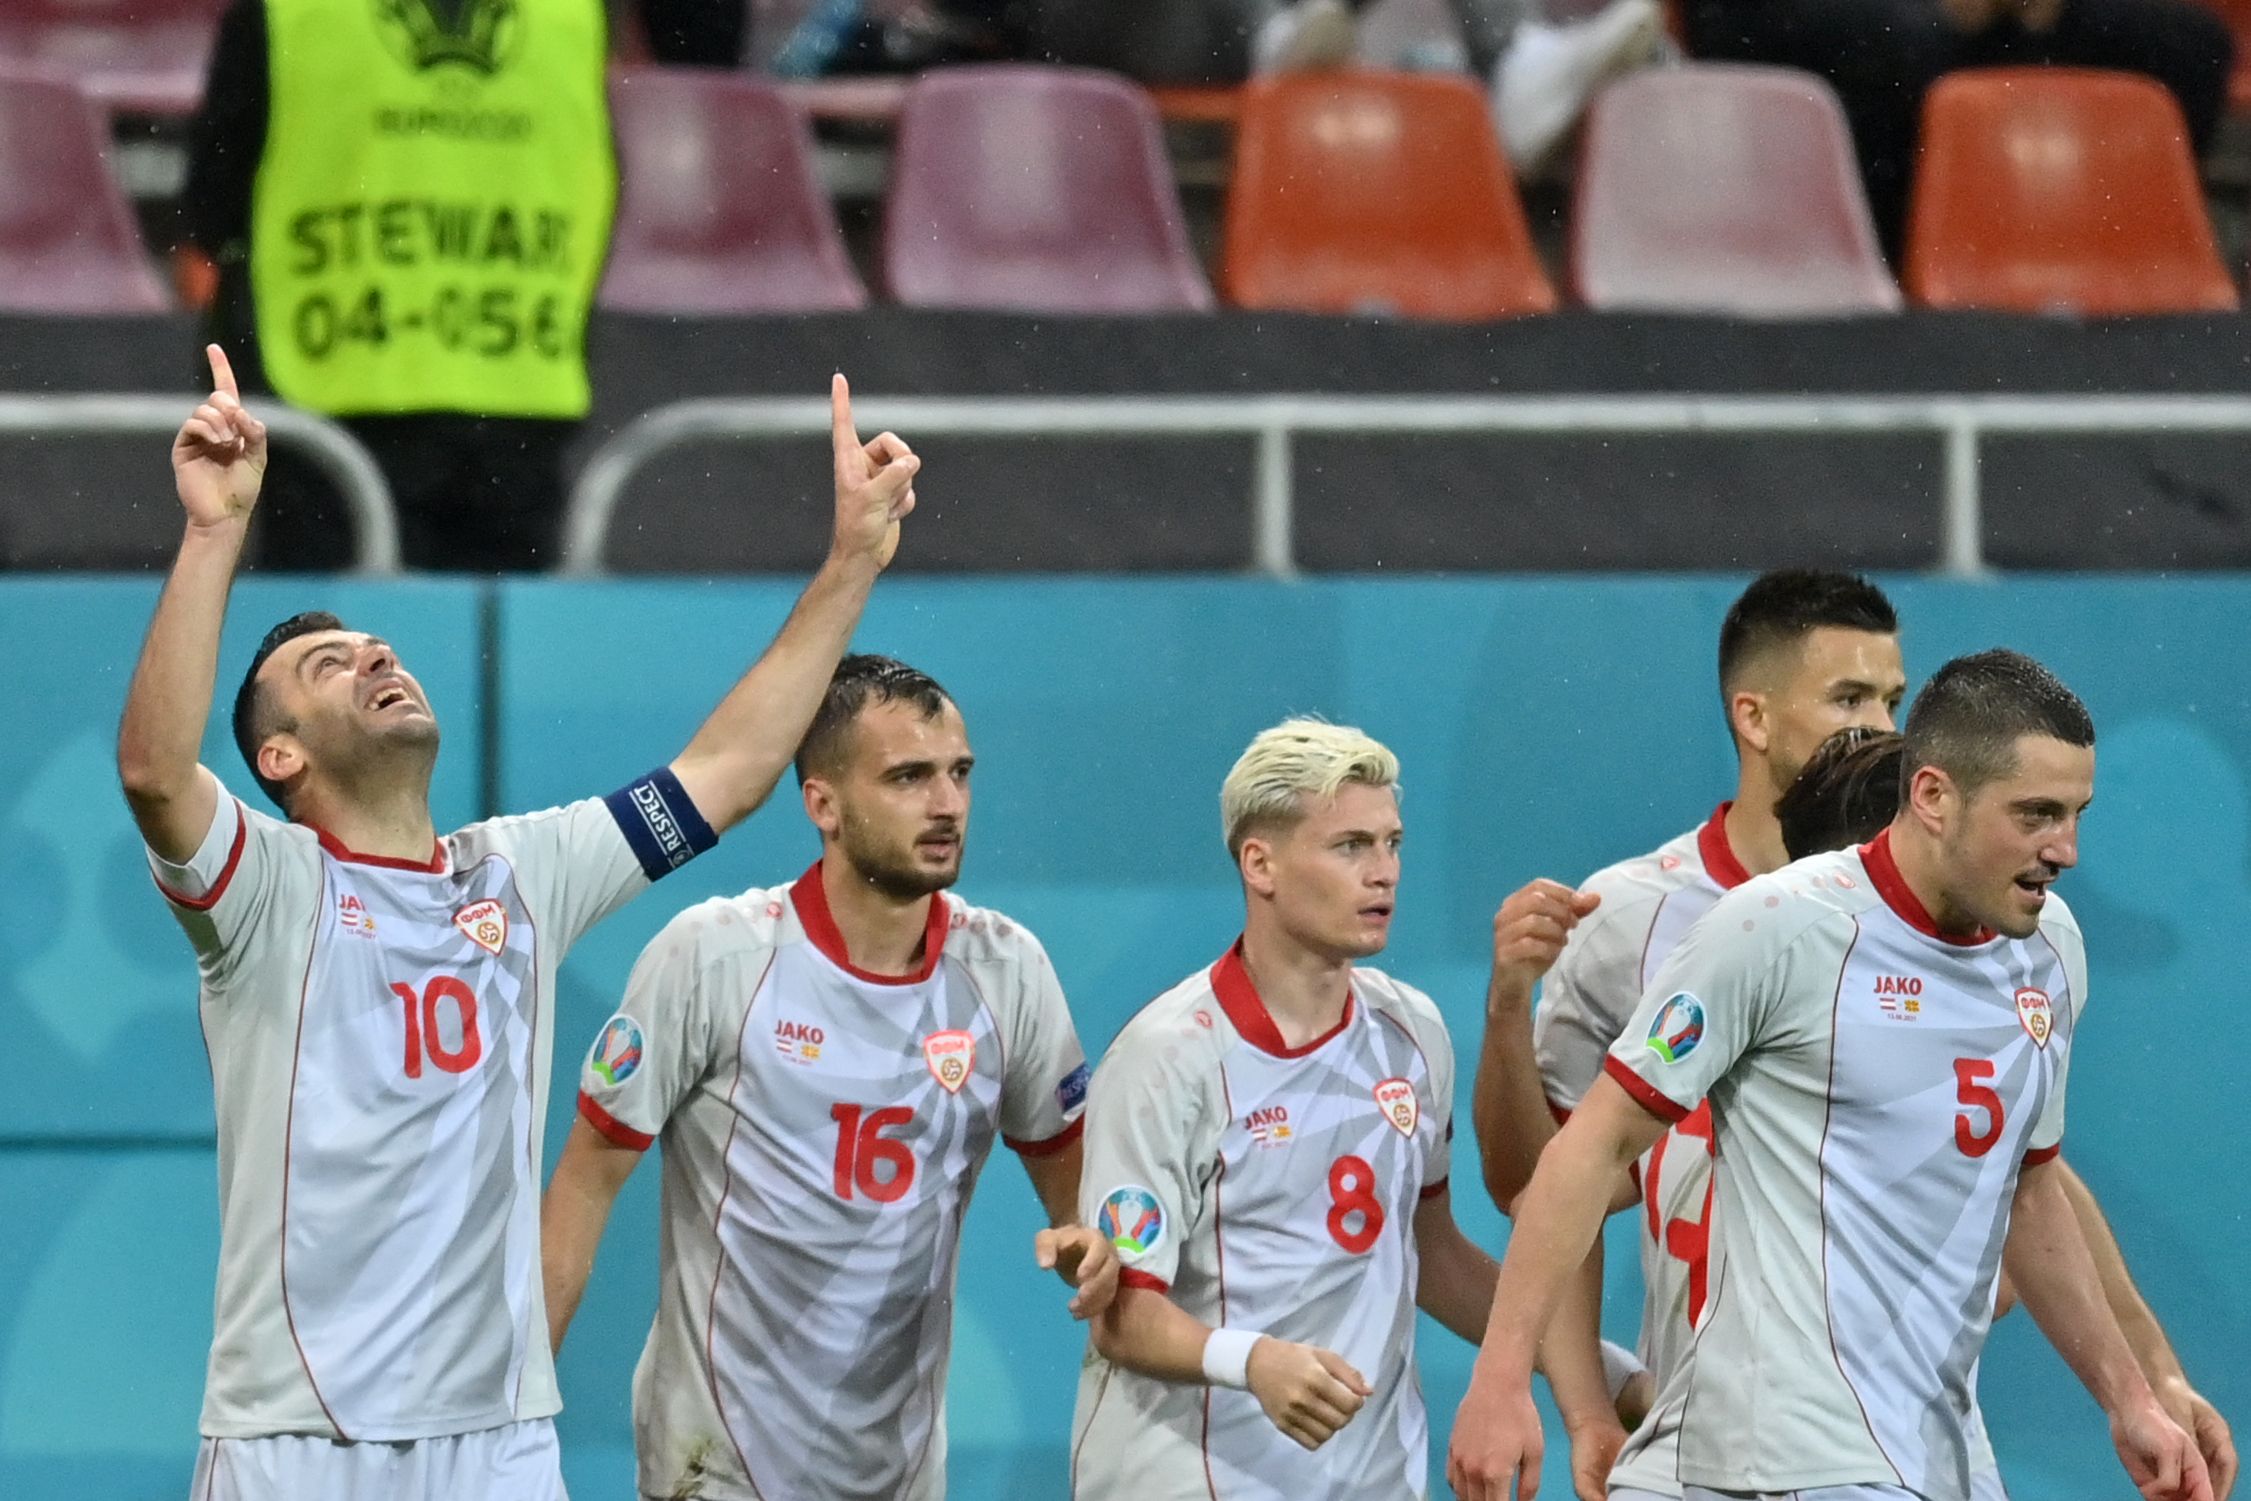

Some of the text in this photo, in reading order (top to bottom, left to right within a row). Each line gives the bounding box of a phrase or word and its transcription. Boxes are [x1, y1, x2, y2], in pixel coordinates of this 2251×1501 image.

[634, 785, 682, 851] RESPECT
[390, 975, 482, 1079] 10
[1873, 976, 1922, 996] JAKO
[774, 1019, 824, 1045] JAKO
[1245, 1106, 1287, 1130] JAKO
[1953, 1057, 2004, 1158] 5
[830, 1103, 915, 1203] 16
[1327, 1155, 1384, 1254] 8
